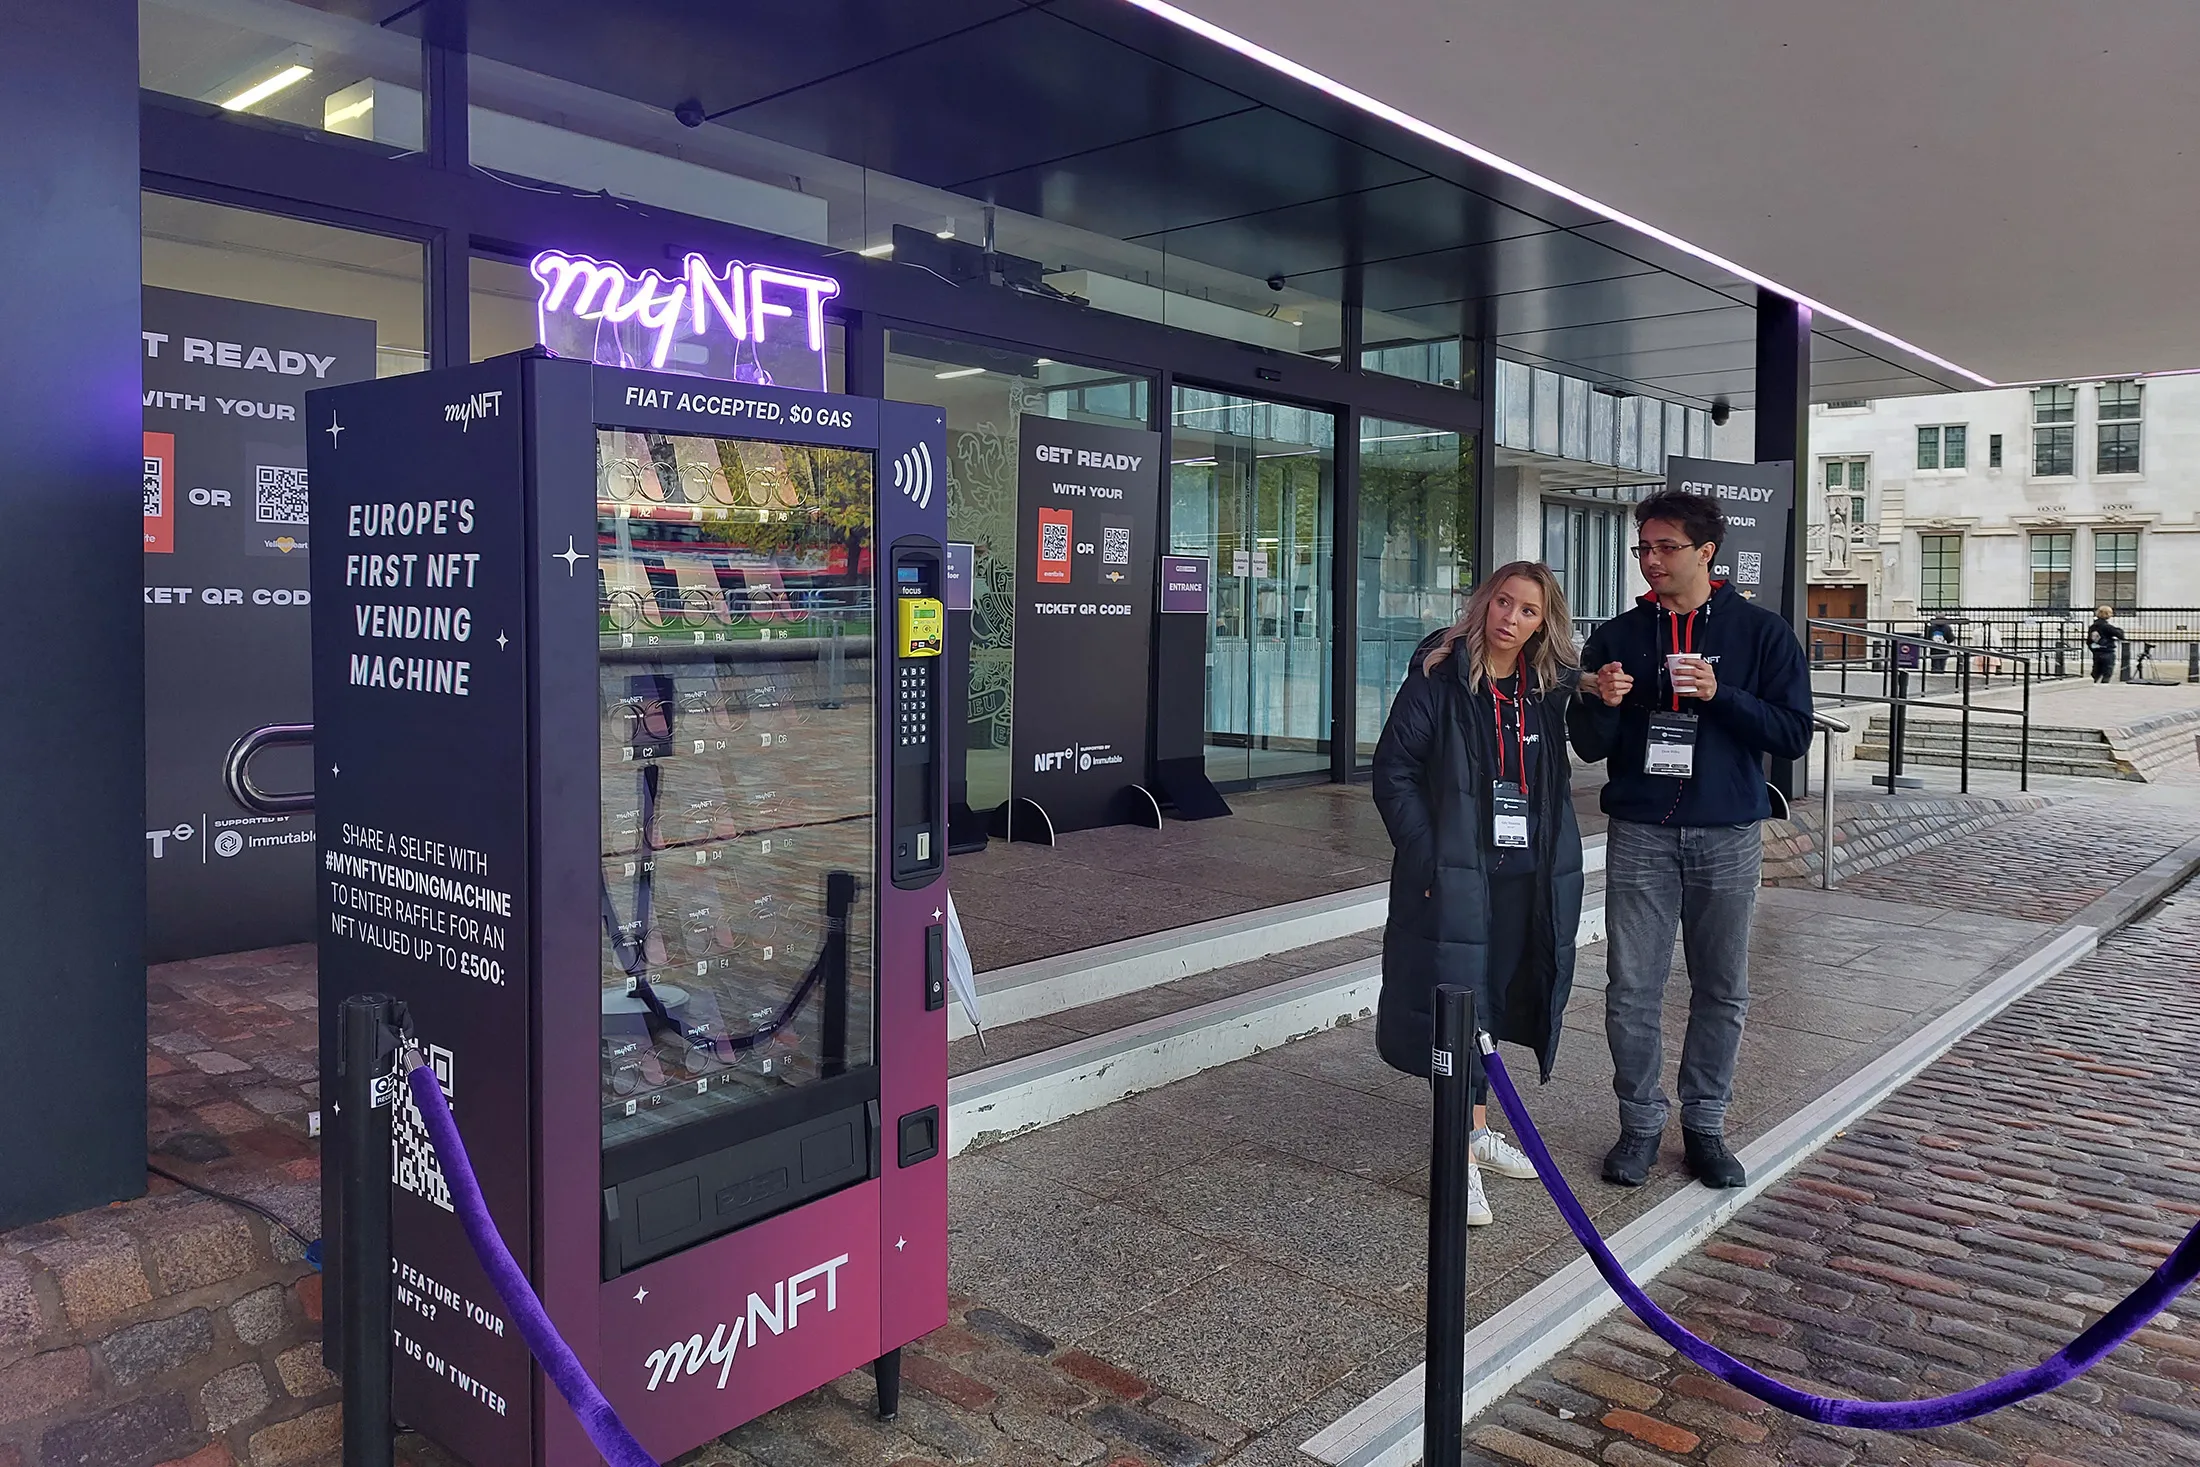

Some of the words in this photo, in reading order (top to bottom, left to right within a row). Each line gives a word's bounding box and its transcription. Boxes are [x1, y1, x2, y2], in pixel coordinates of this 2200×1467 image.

[537, 255, 837, 368] myNFT
[184, 337, 336, 378] READY
[215, 397, 295, 421] YOUR
[444, 390, 503, 433] myNFT
[625, 387, 673, 409] FIAT
[676, 393, 785, 425] ACCEPTED,
[789, 404, 813, 424] $0
[816, 408, 853, 428] GAS
[1036, 445, 1072, 464] GET
[1077, 450, 1142, 471] READY
[1052, 483, 1086, 496] WITH
[1089, 486, 1123, 499] YOUR
[1681, 481, 1712, 496] GET
[1716, 484, 1774, 502] READY
[188, 488, 232, 507] OR
[639, 506, 650, 517] A2
[349, 499, 475, 537] EUROPE'S
[1726, 516, 1756, 527] YOUR
[1076, 543, 1094, 554] OR
[346, 554, 418, 587] FIRST
[426, 554, 480, 588] NFT
[1714, 565, 1730, 576] OR
[902, 586, 922, 595] focus
[1169, 583, 1202, 591] ENTRANCE
[144, 587, 193, 604] KET
[201, 588, 244, 605] QR
[252, 589, 311, 605] COD
[1035, 603, 1076, 615] TICKET
[1080, 604, 1097, 615] QR
[1100, 604, 1132, 615] CODE
[355, 605, 472, 642] VENDING
[648, 636, 659, 645] B2
[715, 633, 725, 641] B4
[778, 631, 788, 639] B6
[1703, 655, 1721, 664] NFT
[350, 653, 471, 696] MACHINE
[911, 667, 916, 675] B
[920, 667, 925, 675] C
[902, 691, 907, 699] G
[912, 702, 916, 710] 2
[912, 713, 916, 721] 5
[921, 724, 925, 732] 9
[778, 735, 788, 744] C6
[716, 741, 726, 750] C4
[642, 748, 653, 757] C2
[1034, 751, 1065, 772] NFT
[1092, 755, 1123, 765] Immutable
[214, 817, 275, 827] SUPPORTED
[783, 839, 793, 848] D6
[342, 823, 384, 852] SHARE
[387, 833, 397, 855] A
[400, 835, 445, 867] SELFIE
[449, 845, 488, 876] WITH
[712, 851, 722, 860] D4
[644, 861, 655, 872] D2
[325, 850, 511, 917] #MYNFTVENDINGMACHINE
[331, 882, 348, 905] TO
[351, 887, 392, 919] ENTER
[395, 899, 446, 934] RAFFLE
[450, 914, 479, 944] FOR
[483, 924, 505, 951] AN
[331, 912, 355, 939] NFT
[358, 920, 410, 955] VALUED
[414, 937, 433, 962] UP
[437, 944, 457, 970] TO
[460, 952, 505, 987] £500:
[786, 944, 795, 953] E6
[720, 959, 729, 969] E4
[651, 974, 661, 984] E2
[783, 1055, 792, 1065] F6
[721, 1075, 730, 1085] F4
[652, 1095, 661, 1106] F2
[397, 1285, 437, 1321] NFTs?
[402, 1263, 461, 1312] FEATURE
[465, 1300, 504, 1338] YOUR
[644, 1252, 849, 1391] myNFT
[405, 1337, 422, 1361] US
[425, 1352, 445, 1376] ON
[449, 1364, 507, 1417] TWTTER
